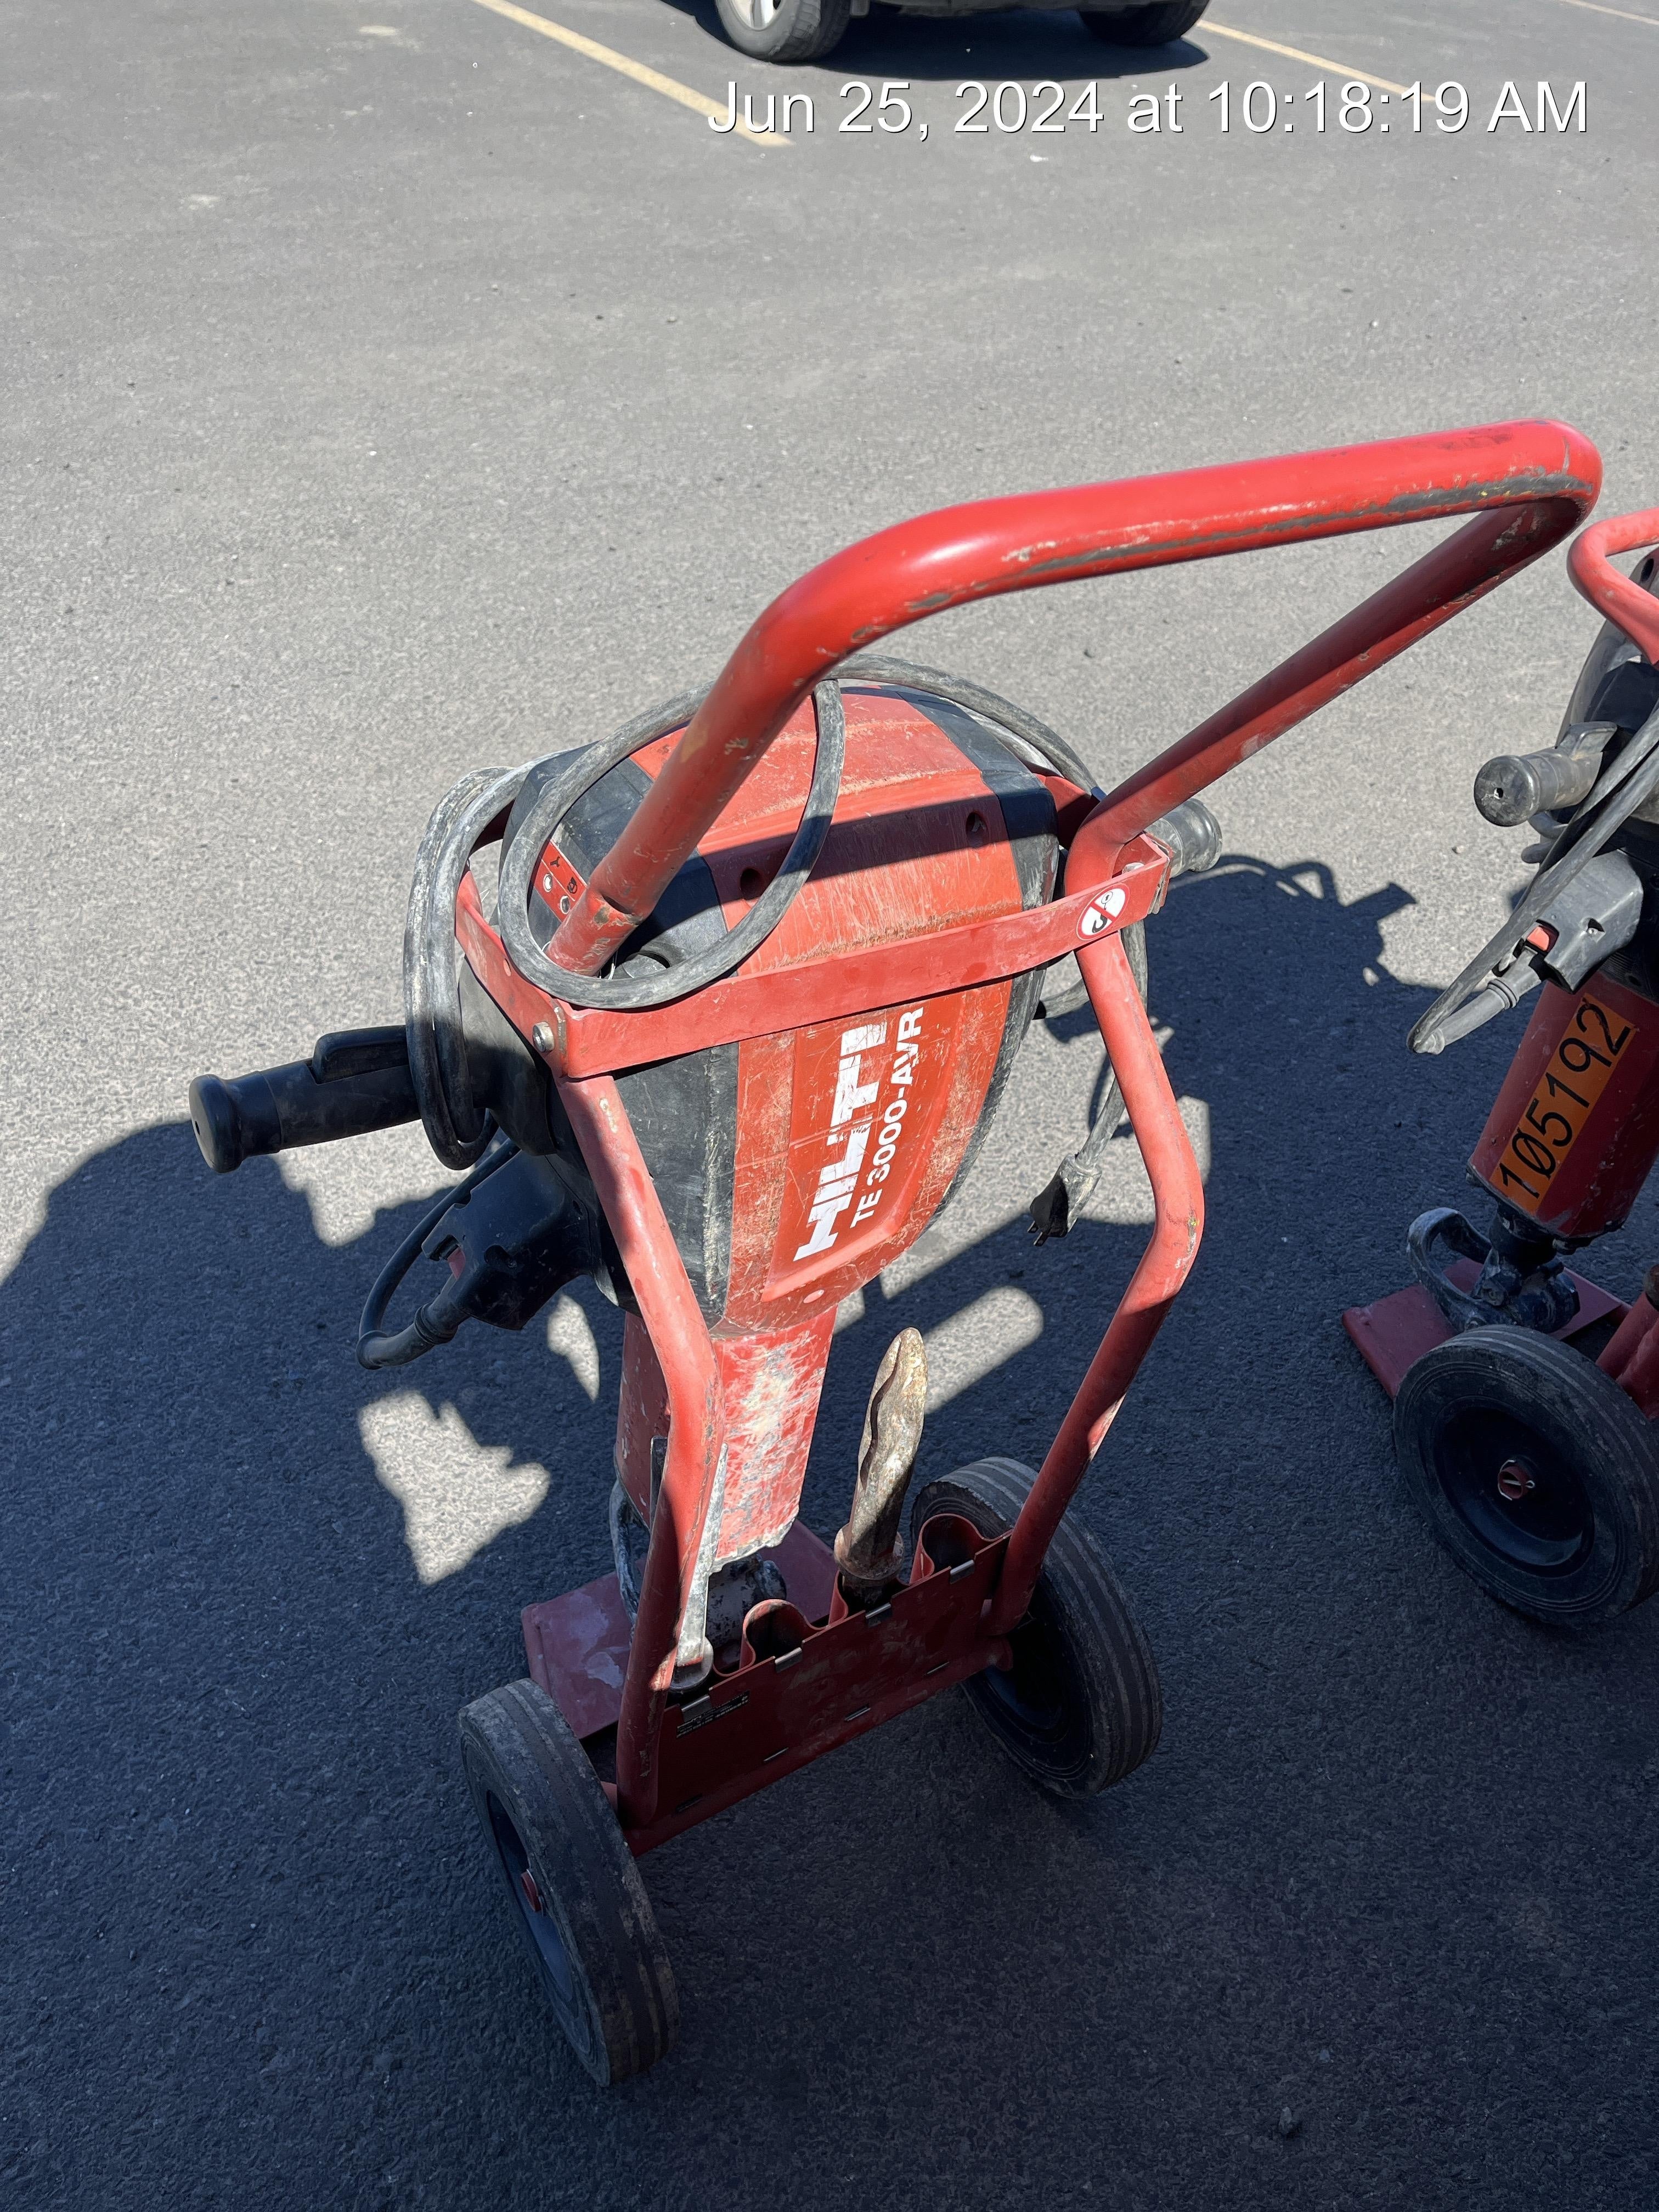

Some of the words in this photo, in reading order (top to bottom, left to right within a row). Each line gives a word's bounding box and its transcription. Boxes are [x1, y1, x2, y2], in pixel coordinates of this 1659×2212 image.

[793, 1021, 888, 1262] HILTI
[850, 1188, 883, 1229] TE
[867, 1006, 924, 1186] 3000-AVR
